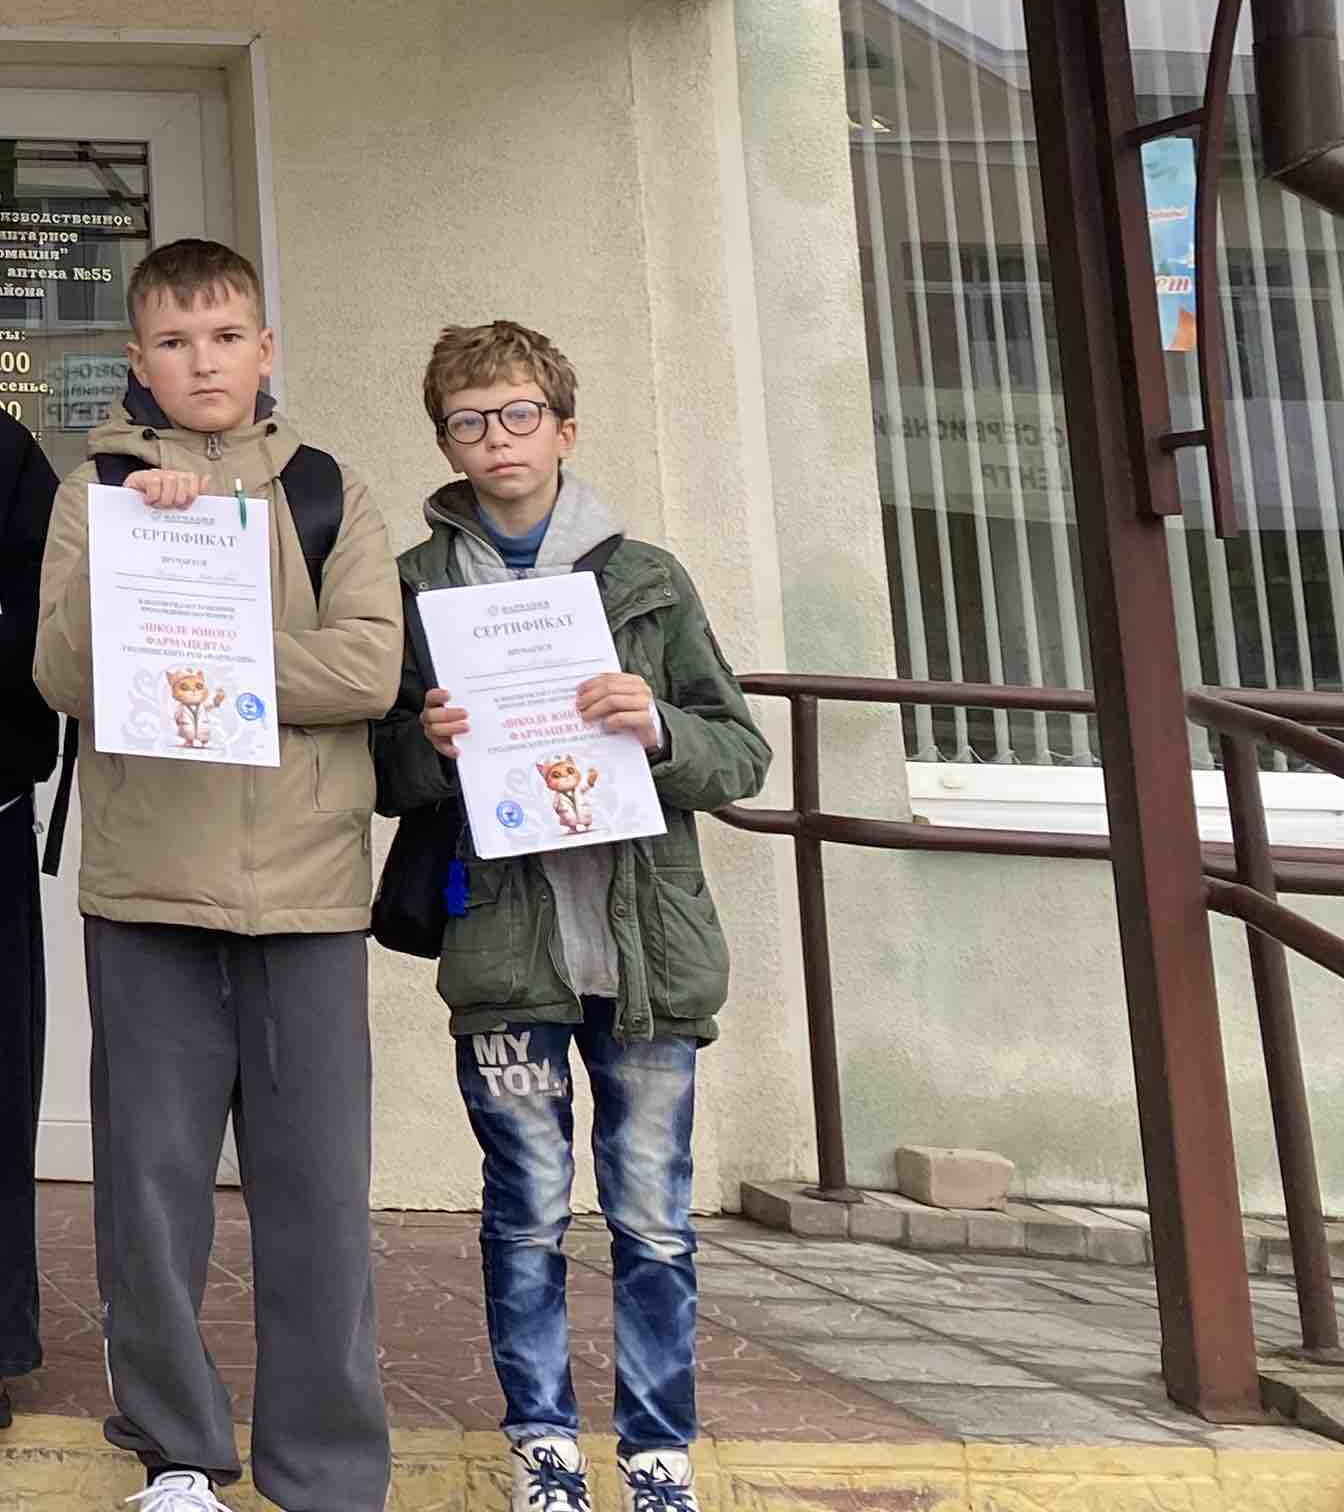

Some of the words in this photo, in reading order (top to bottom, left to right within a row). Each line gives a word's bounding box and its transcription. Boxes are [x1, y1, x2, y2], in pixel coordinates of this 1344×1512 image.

[7, 268, 68, 281] аптека
[73, 267, 112, 281] №55
[131, 527, 238, 547] СЕРТИФИКАТ
[473, 614, 575, 639] СЕРТИФИКАТ
[473, 1031, 530, 1065] MY
